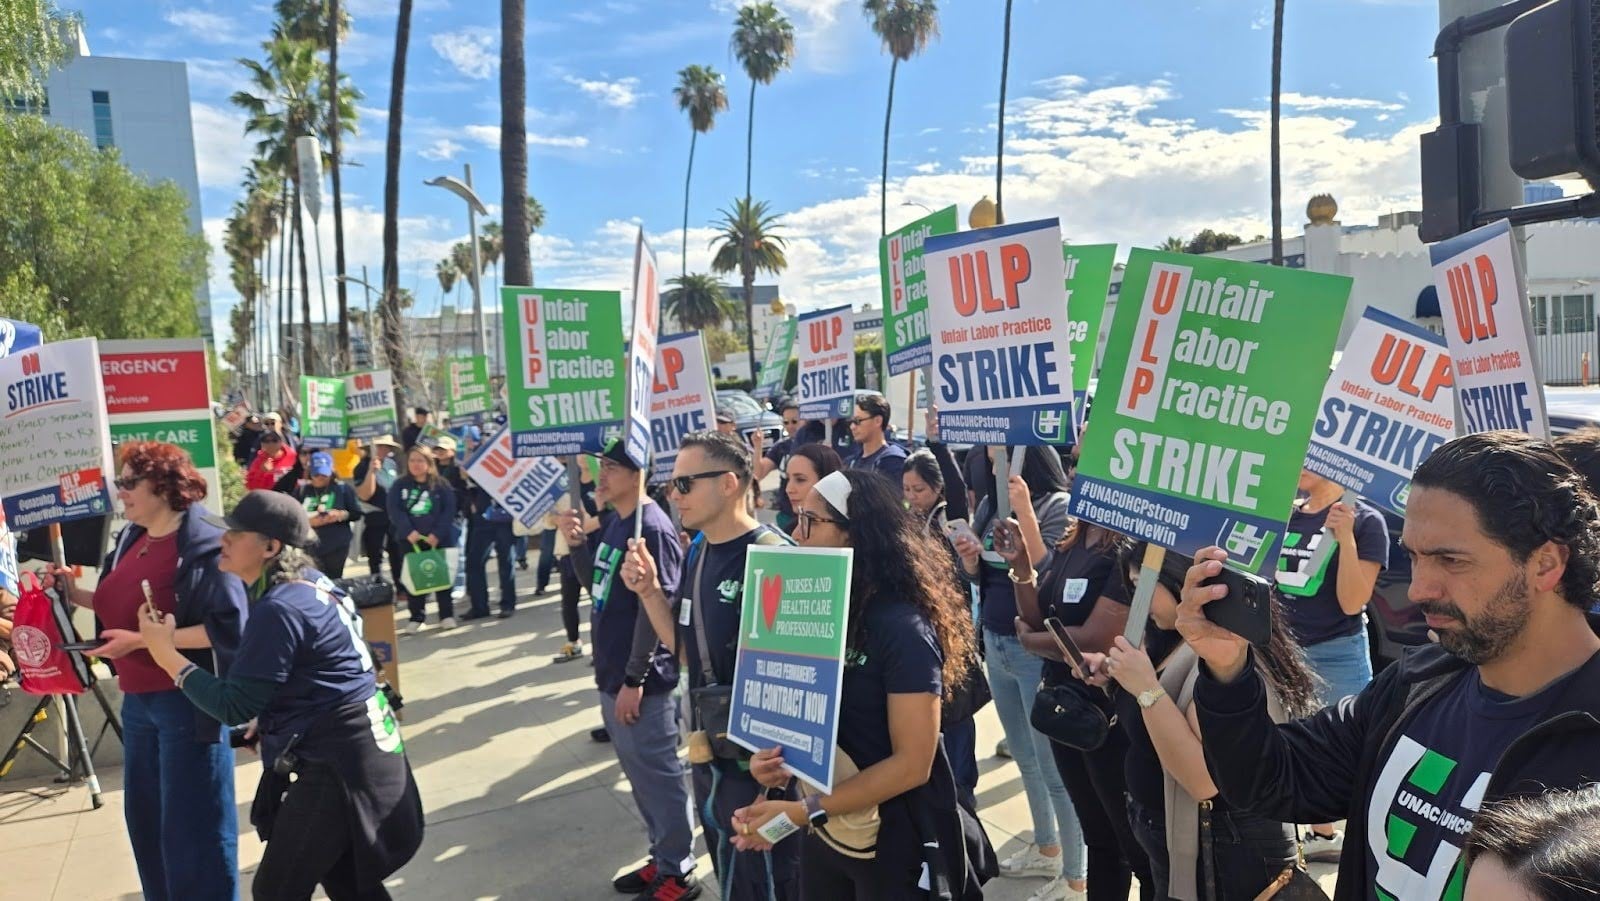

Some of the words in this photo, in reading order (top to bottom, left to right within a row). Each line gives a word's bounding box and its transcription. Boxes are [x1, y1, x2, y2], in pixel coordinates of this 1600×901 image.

[948, 243, 1032, 318] ULP
[1446, 254, 1499, 345] ULP
[809, 315, 843, 354] ULP
[894, 309, 931, 347] STRI
[941, 329, 968, 344] Unfair
[971, 323, 1000, 341] Labor
[1002, 316, 1052, 337] Practice
[22, 352, 41, 376] ON
[102, 358, 178, 375] ERGENCY
[652, 347, 685, 394] LP
[938, 341, 1060, 404] STRIKE
[1370, 333, 1454, 403] ULP
[1491, 349, 1521, 372] Practice
[8, 372, 68, 410] STRIKE
[345, 390, 390, 410] STRIKE
[354, 373, 373, 391] ON
[801, 364, 850, 399] STRIKE
[528, 388, 614, 427] STRIKE
[940, 414, 1011, 430] #UNACUHCPstrong
[1340, 379, 1374, 401] Unfair
[1374, 391, 1406, 415] Labor
[1407, 403, 1453, 430] Practice
[154, 429, 199, 443] CARE
[650, 409, 706, 453] RIKE
[941, 429, 1007, 444] #TogetherWeWin
[480, 436, 516, 477] UL
[1108, 427, 1266, 510] STRIKE
[61, 472, 80, 489] ULP
[505, 457, 559, 512] STRIKE
[1075, 499, 1178, 546] #TogetherWeWin
[1080, 481, 1190, 531] #UNACUHCPstrong
[749, 568, 764, 639] I
[785, 578, 813, 594] NURSES
[814, 576, 832, 593] AND
[781, 599, 809, 615] HEALTH
[810, 599, 832, 615] CARE
[776, 620, 835, 639] PROFESSIONALS
[743, 679, 762, 708] FAIR
[762, 682, 805, 719] CONTRACT
[804, 690, 828, 725] NOW
[1397, 790, 1473, 836] UNAC/UHCP
